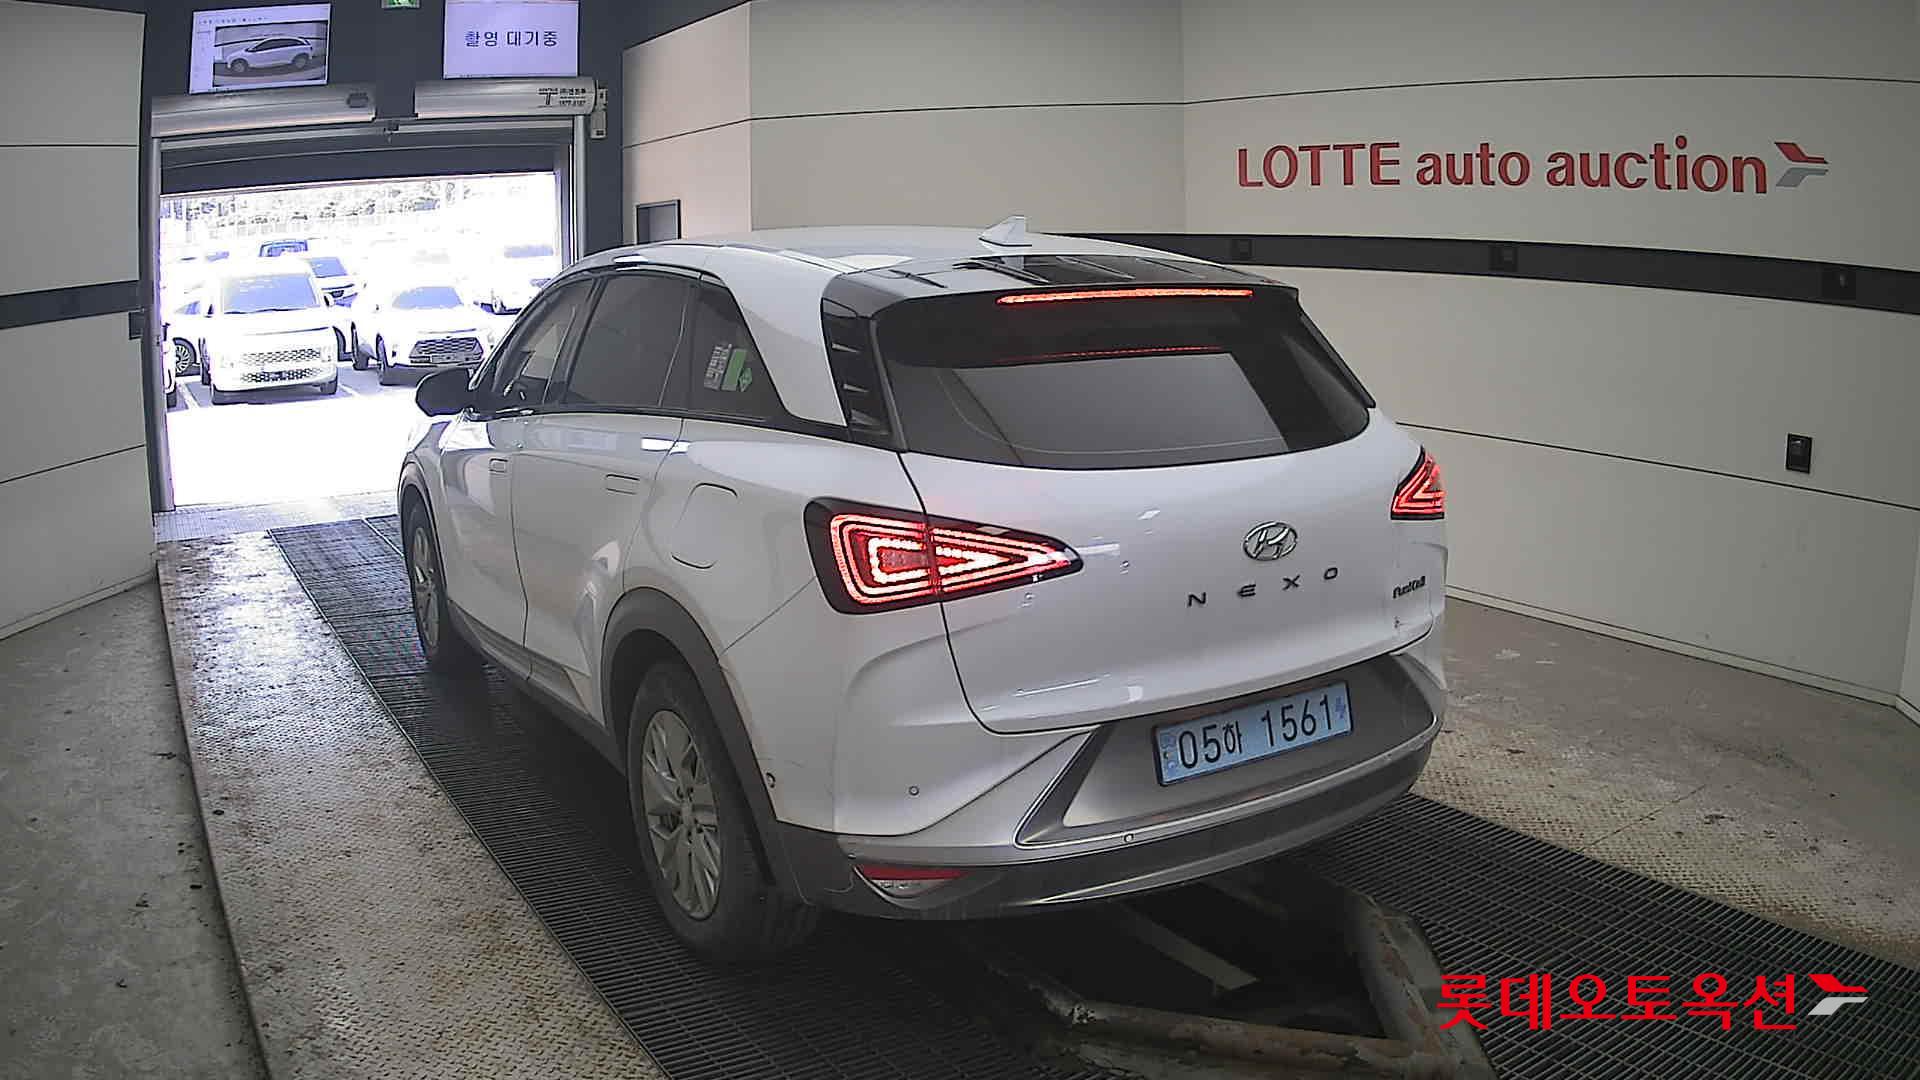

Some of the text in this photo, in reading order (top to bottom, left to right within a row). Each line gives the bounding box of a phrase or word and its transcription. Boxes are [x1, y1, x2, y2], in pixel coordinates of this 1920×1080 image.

[506, 31, 558, 47] 대기중
[1238, 135, 1767, 194] LOTTE auto auction
[1187, 567, 1339, 607] NEXO
[1178, 694, 1332, 769] 05하 1561
